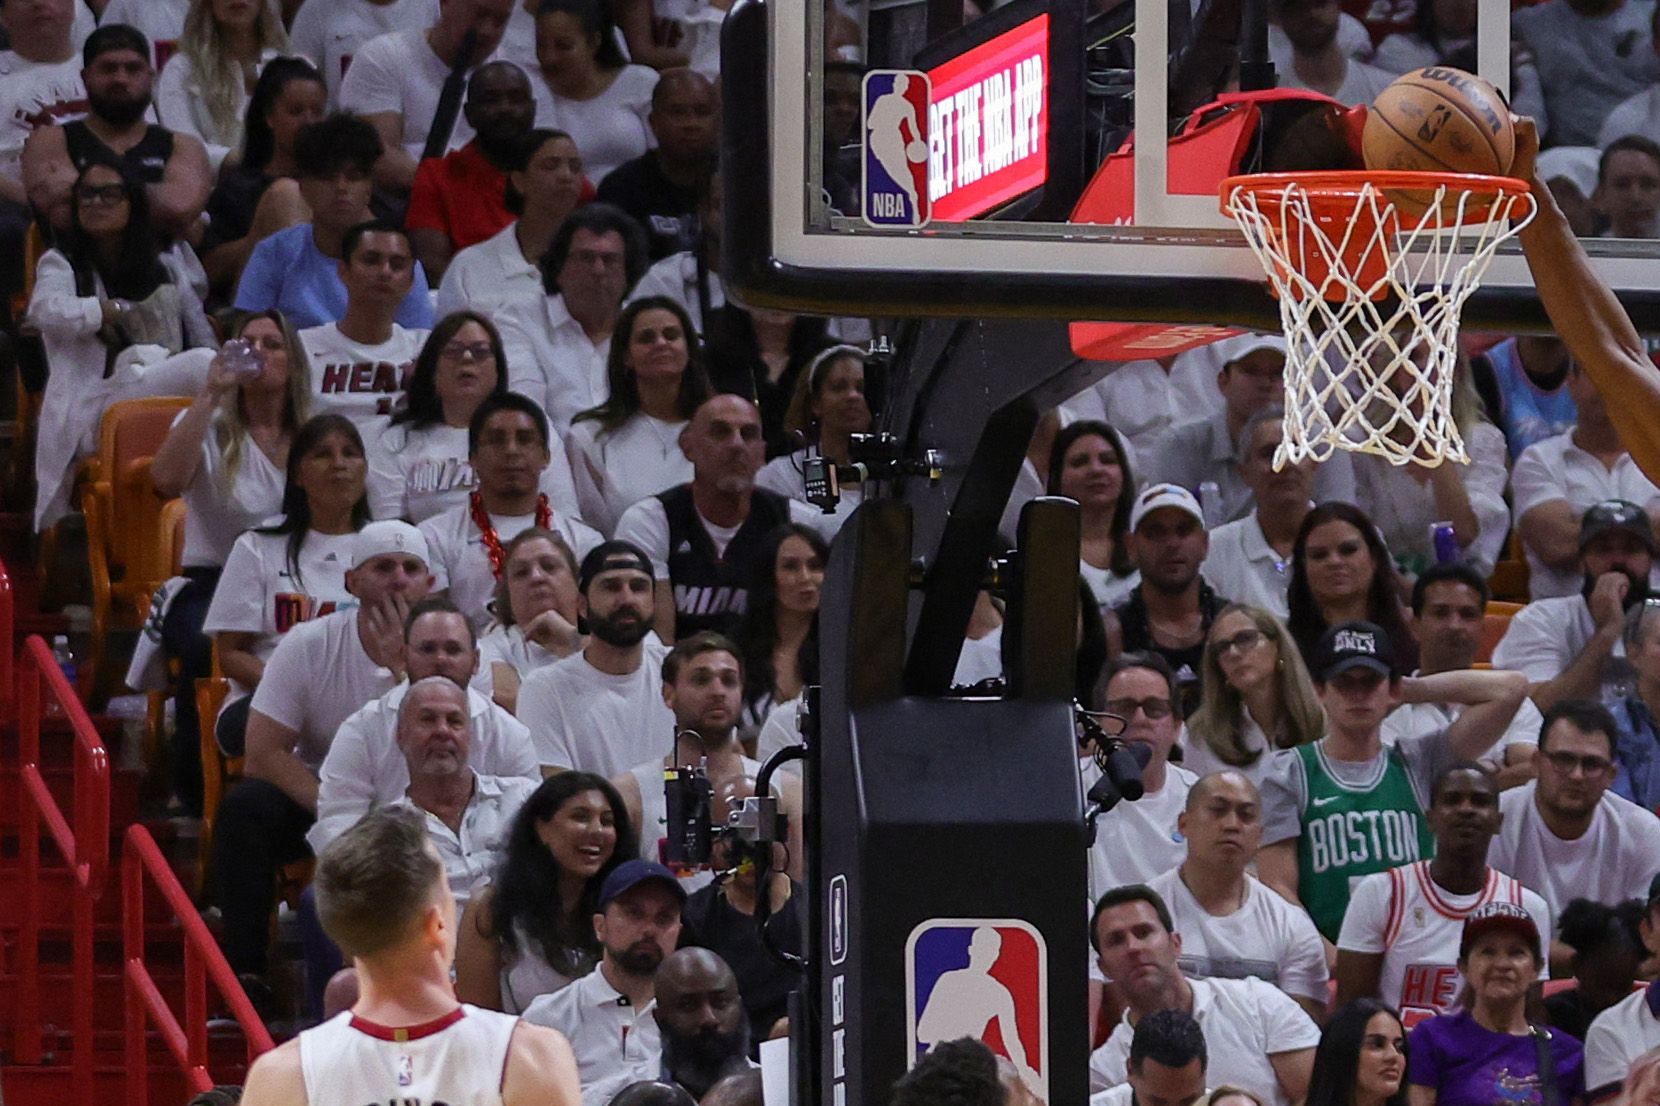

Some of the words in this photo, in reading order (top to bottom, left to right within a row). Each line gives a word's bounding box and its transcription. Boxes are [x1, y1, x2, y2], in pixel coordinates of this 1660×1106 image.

[955, 81, 983, 188] THE
[983, 68, 1013, 176] NBA
[1013, 54, 1043, 162] APP
[872, 193, 906, 218] NBA
[1308, 810, 1421, 875] BOSTON
